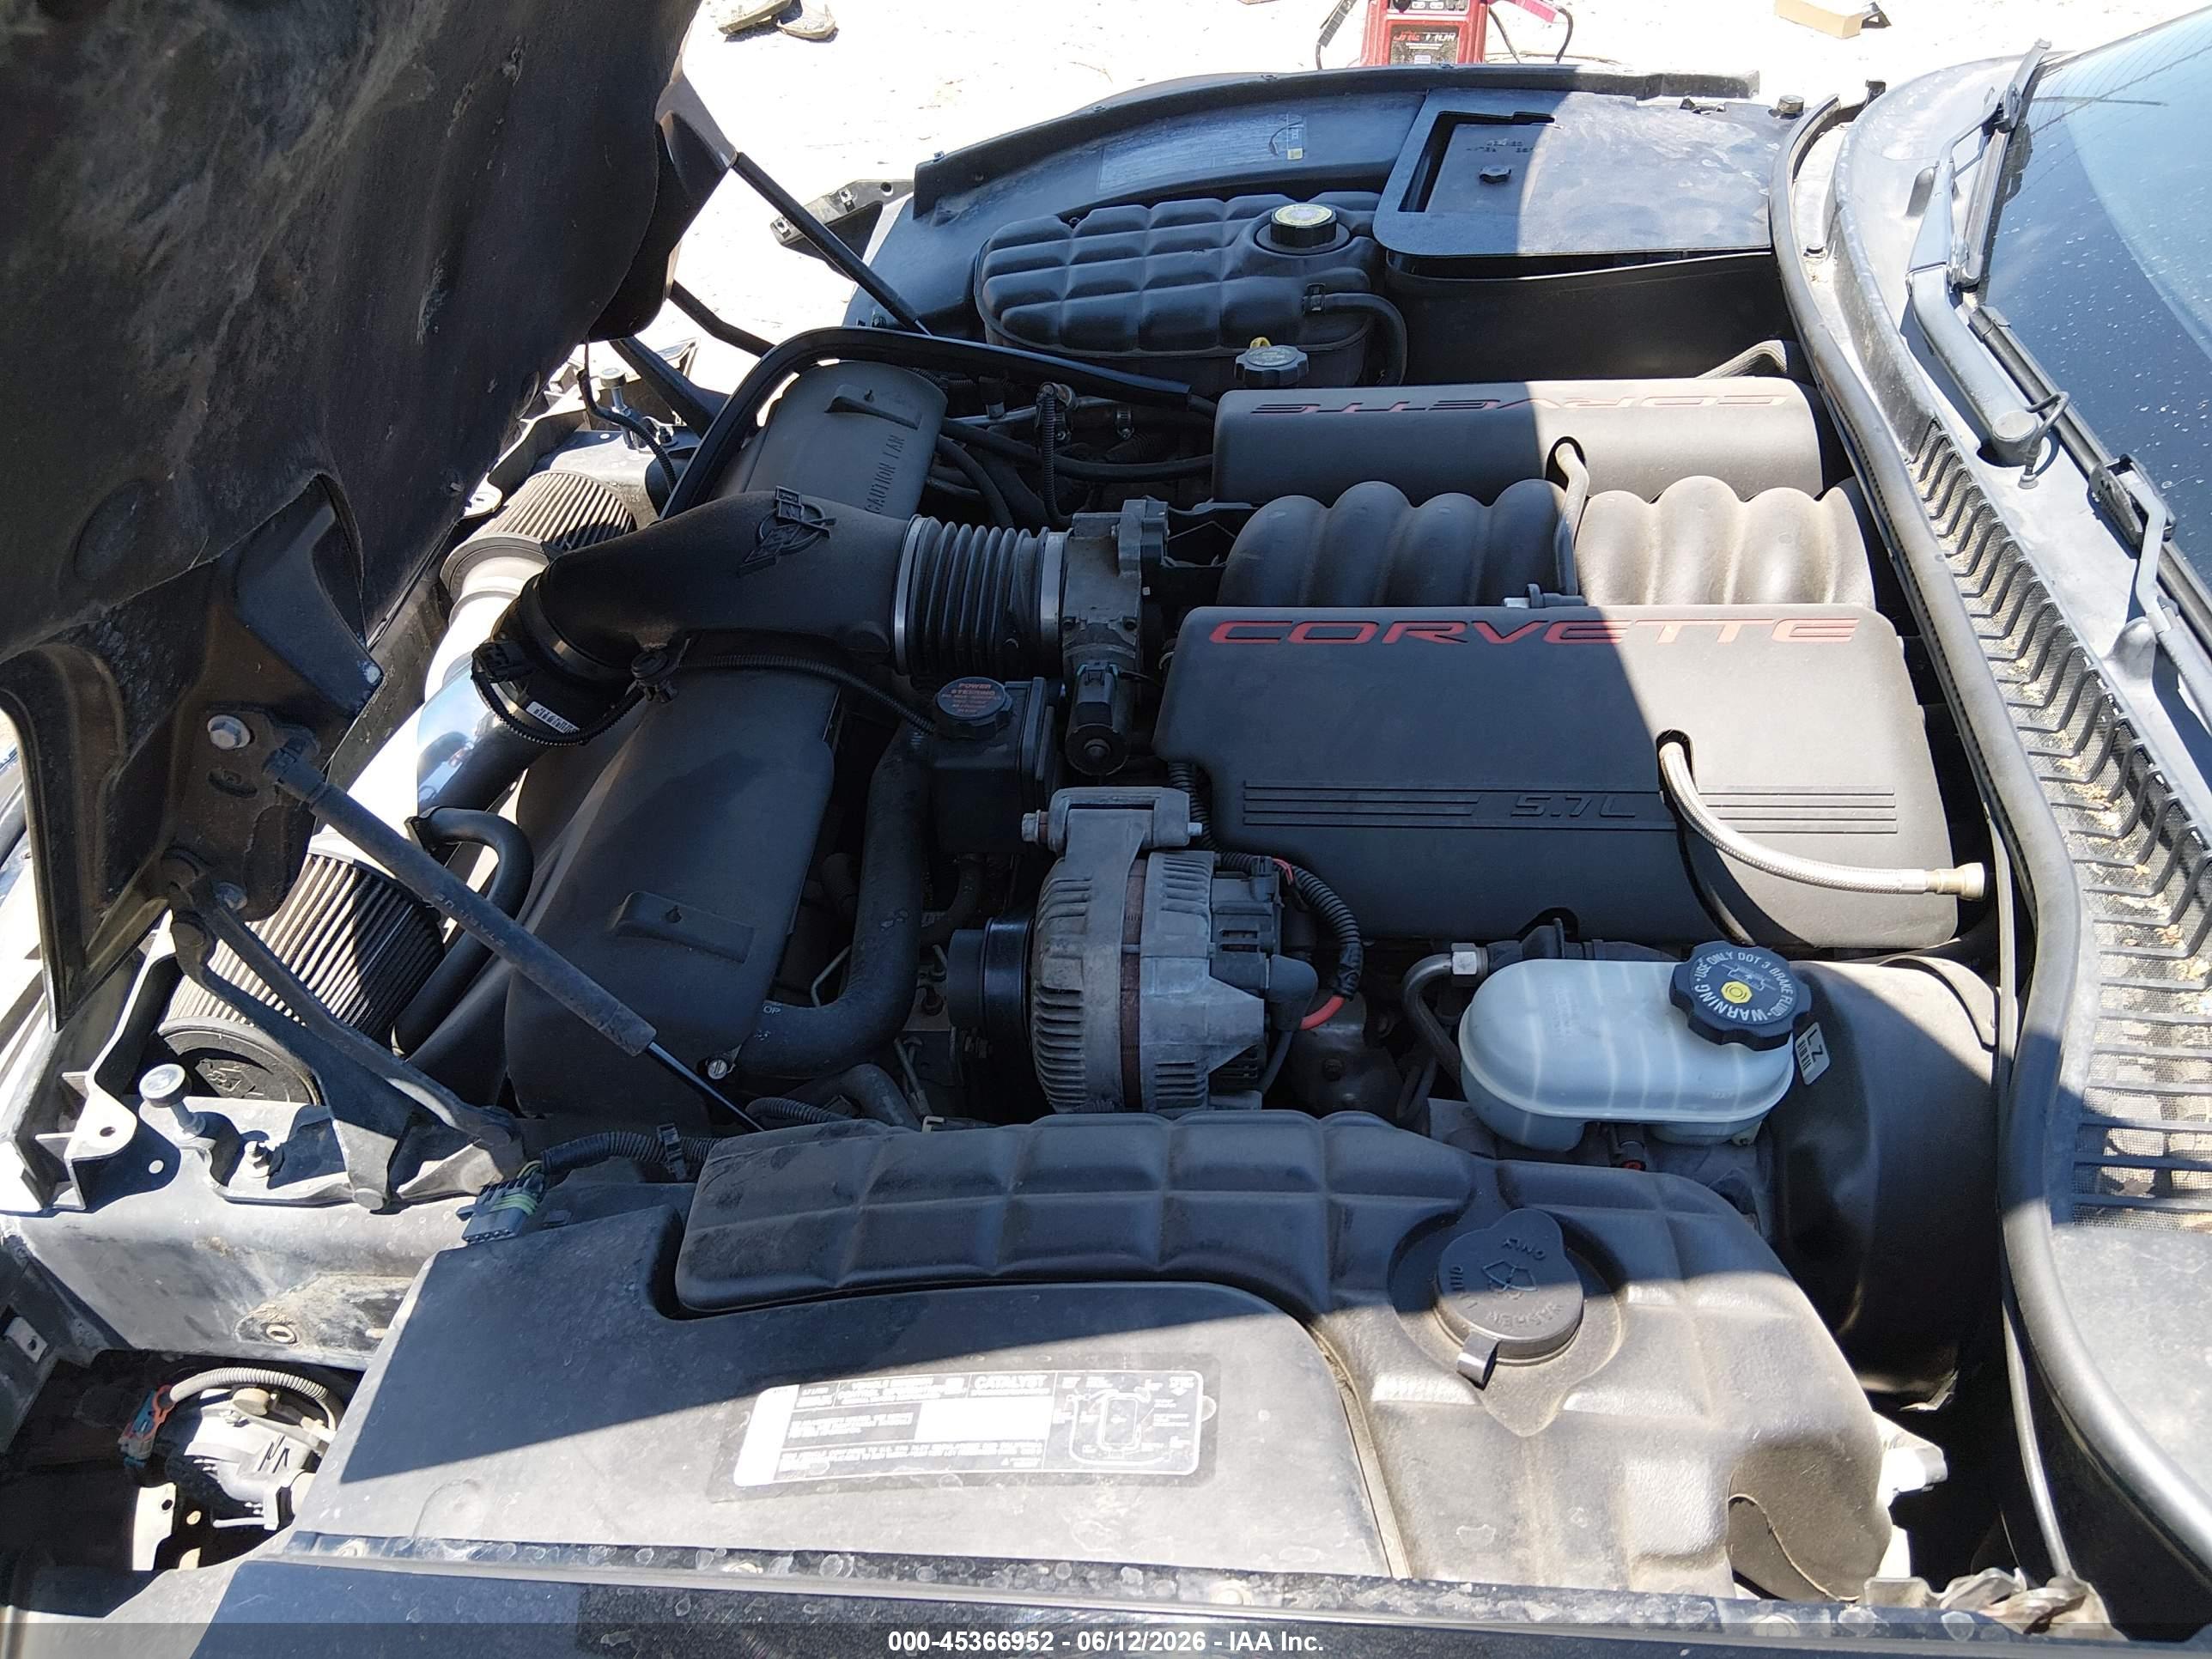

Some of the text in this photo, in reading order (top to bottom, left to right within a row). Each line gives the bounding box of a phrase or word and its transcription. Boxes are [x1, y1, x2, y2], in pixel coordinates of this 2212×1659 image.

[1251, 393, 1789, 416] CORVETTE
[1209, 618, 1861, 646] CORVETTE
[1510, 793, 1638, 818] 5.7L
[1705, 951, 1734, 965] ONLY
[1737, 951, 1760, 964] DOT
[1761, 961, 1771, 969] 3
[1770, 967, 1795, 997] BRAKE
[1694, 984, 1768, 1023] WARNING
[1772, 993, 1794, 1018] FLUID
